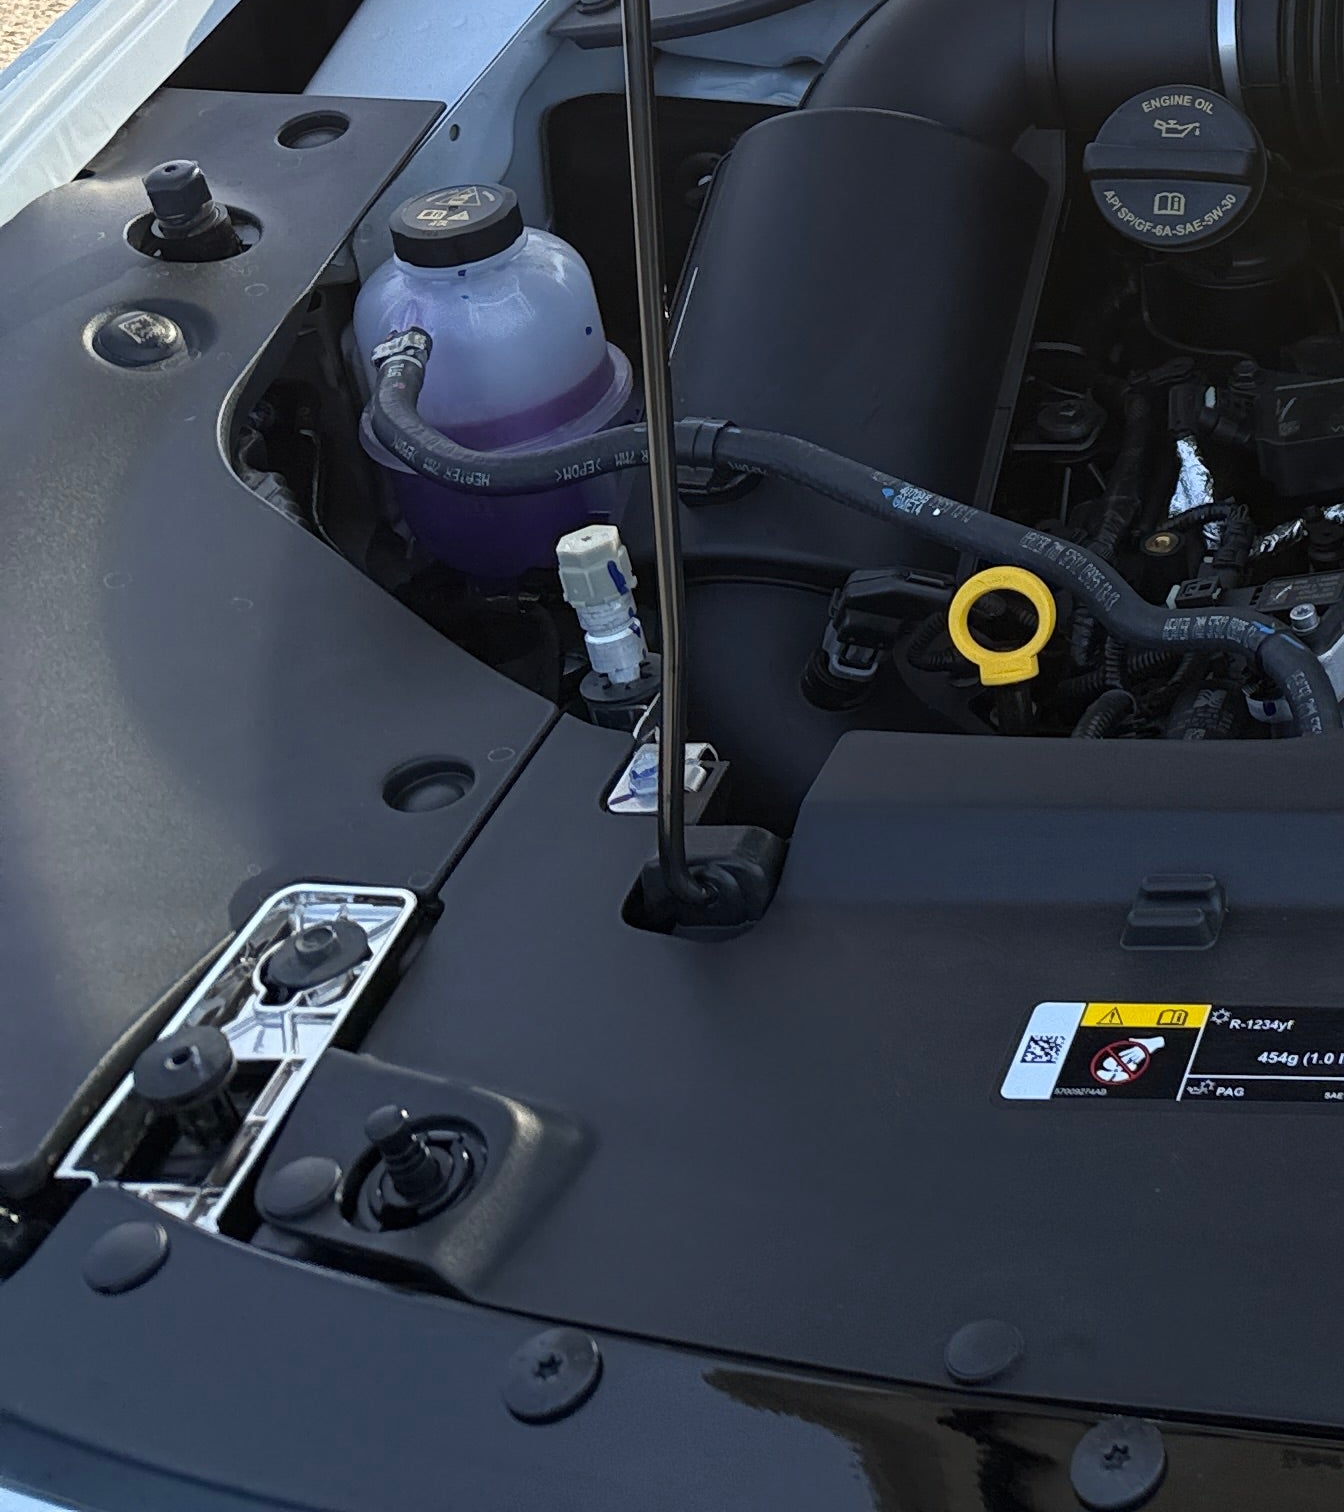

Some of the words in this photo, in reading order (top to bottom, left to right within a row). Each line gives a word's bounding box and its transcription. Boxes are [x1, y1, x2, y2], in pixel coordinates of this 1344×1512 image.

[1141, 94, 1193, 113] ENGINE
[1194, 98, 1215, 115] OIL
[1103, 189, 1122, 211] API
[442, 467, 491, 487] HEATER
[1229, 1018, 1295, 1033] R-1234yf
[1257, 1052, 1299, 1067] 454g
[1303, 1052, 1335, 1067] (1.0
[1215, 1086, 1245, 1098] PAG
[1324, 1091, 1344, 1100] SAE
